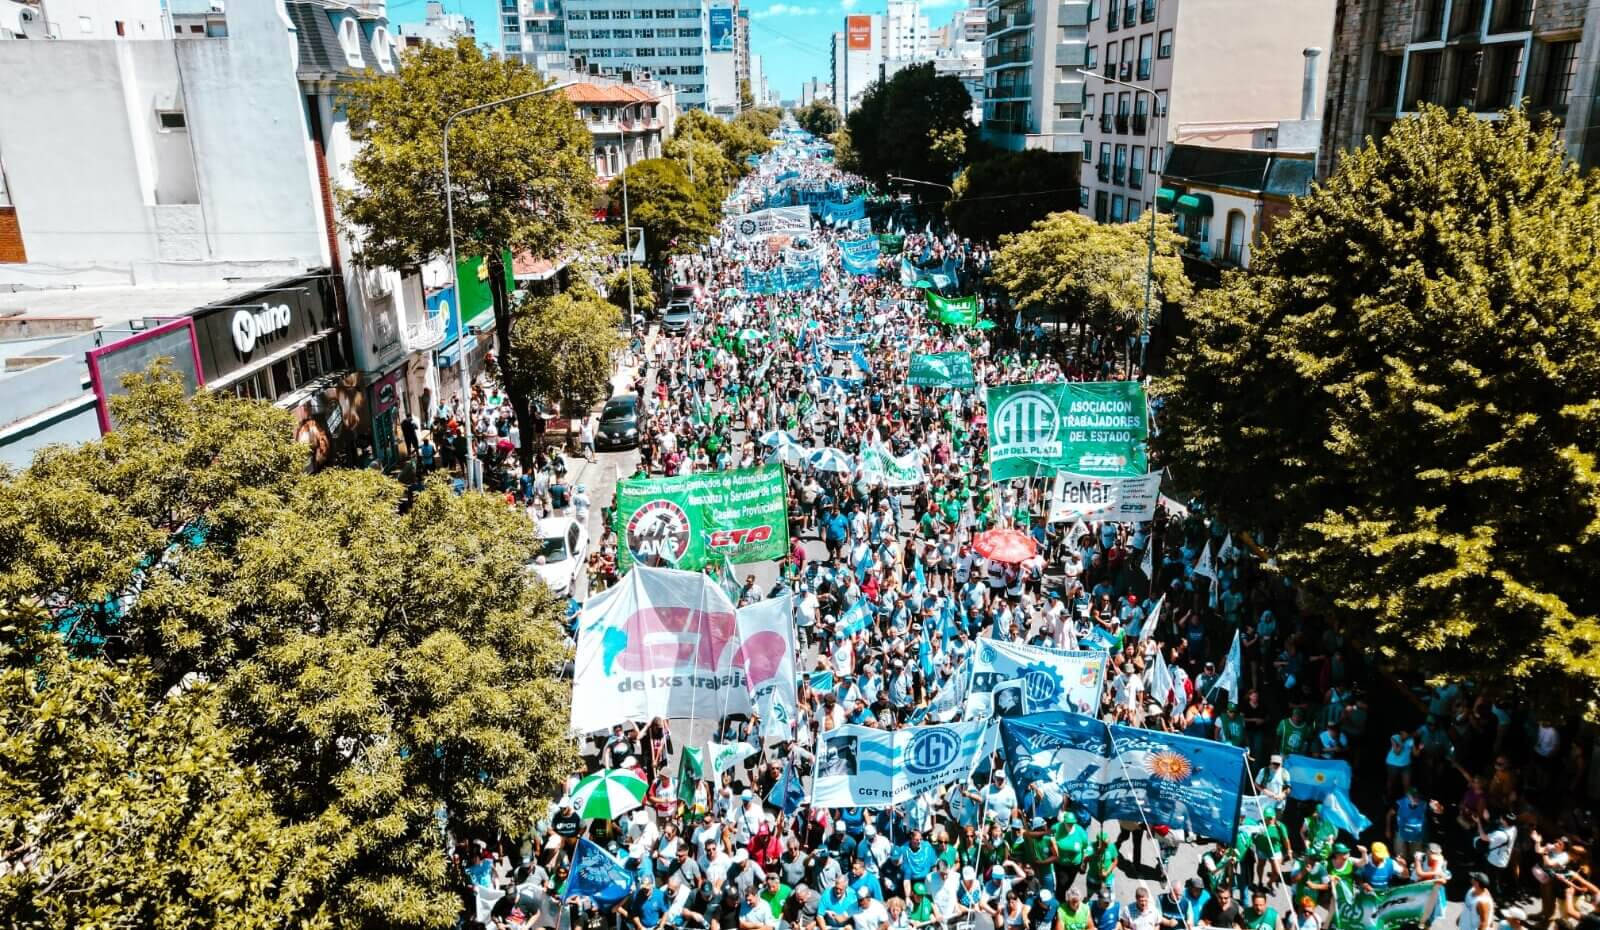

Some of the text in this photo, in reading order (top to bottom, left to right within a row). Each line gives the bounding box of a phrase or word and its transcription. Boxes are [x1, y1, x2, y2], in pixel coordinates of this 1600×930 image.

[1070, 401, 1132, 414] ASOCIACION
[1000, 398, 1054, 445] ATE
[1063, 415, 1140, 428] TRABAJADORES
[1069, 430, 1131, 442] DEL ESTADO
[993, 445, 1059, 457] MAR DEL PLATA
[711, 525, 772, 547] CTA
[617, 677, 646, 693] de
[651, 674, 682, 689] lxs
[914, 733, 951, 768] CGT
[858, 787, 879, 797] CGT
[881, 778, 929, 799] REGIONAL
